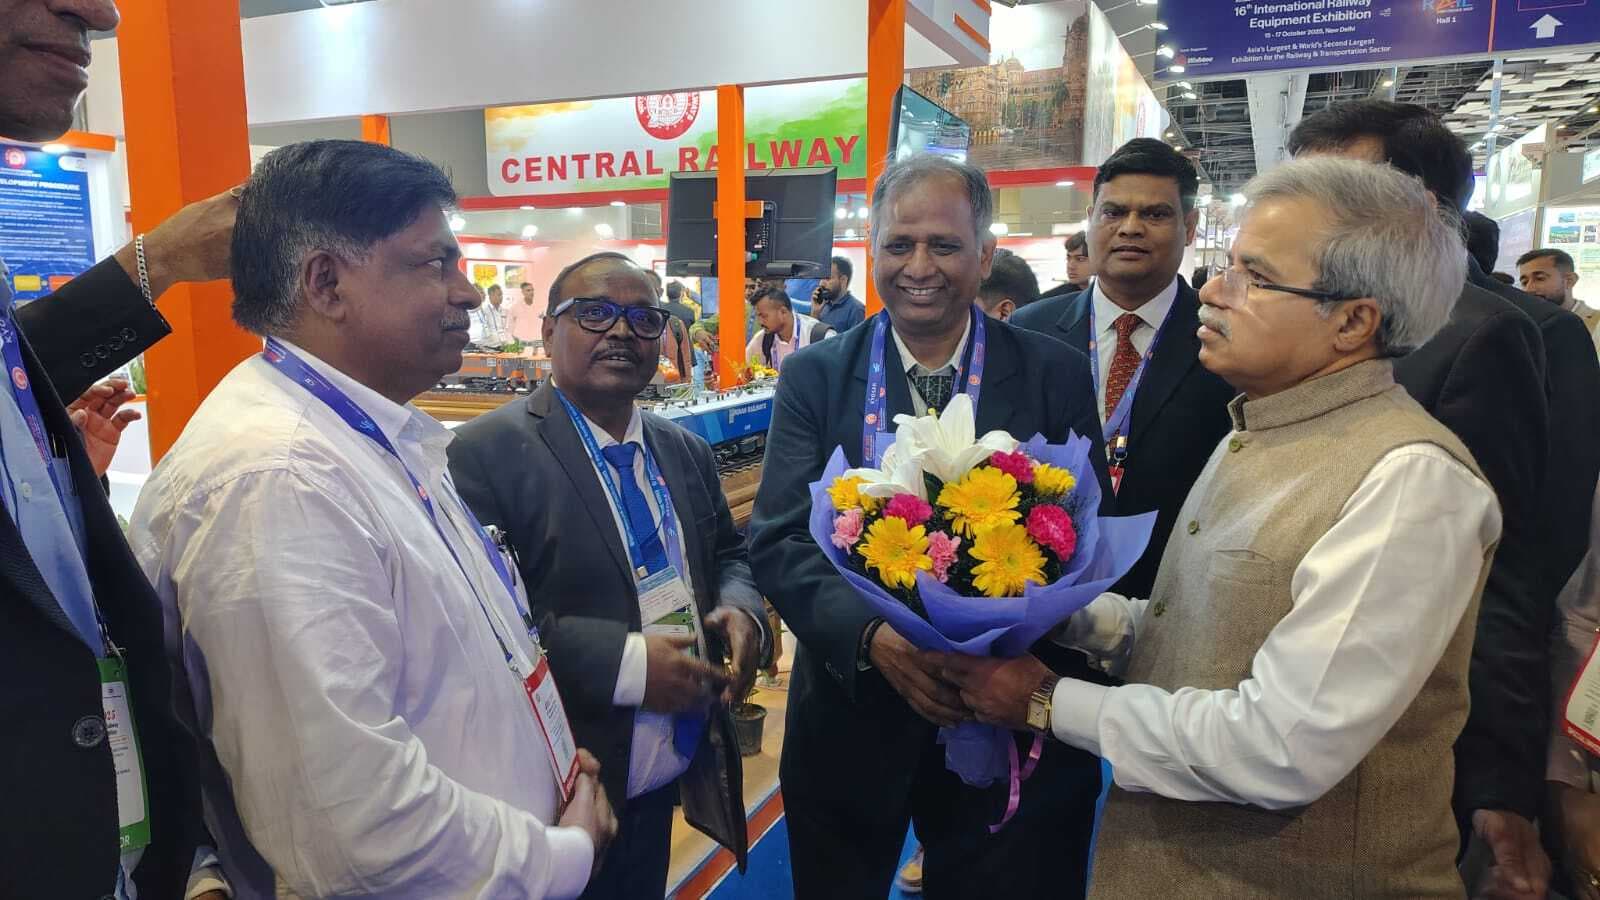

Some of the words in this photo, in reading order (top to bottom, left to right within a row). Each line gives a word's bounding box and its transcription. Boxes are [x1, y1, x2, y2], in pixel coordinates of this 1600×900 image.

[1234, 4, 1253, 16] 16th
[1254, 0, 1325, 14] International
[1327, 0, 1371, 8] Railway
[1249, 14, 1311, 29] Equipment
[1312, 9, 1372, 23] Exhibition
[1436, 16, 1451, 24] Hall
[1266, 44, 1291, 53] Largest
[1323, 39, 1348, 48] Second
[1348, 37, 1376, 47] Largest
[1231, 54, 1263, 63] Exhibition
[1286, 52, 1312, 60] Railway
[1320, 48, 1368, 57] Transportation
[1368, 46, 1392, 54] Sector
[501, 149, 663, 185] CENTRAL
[678, 135, 859, 173] RALWAY
